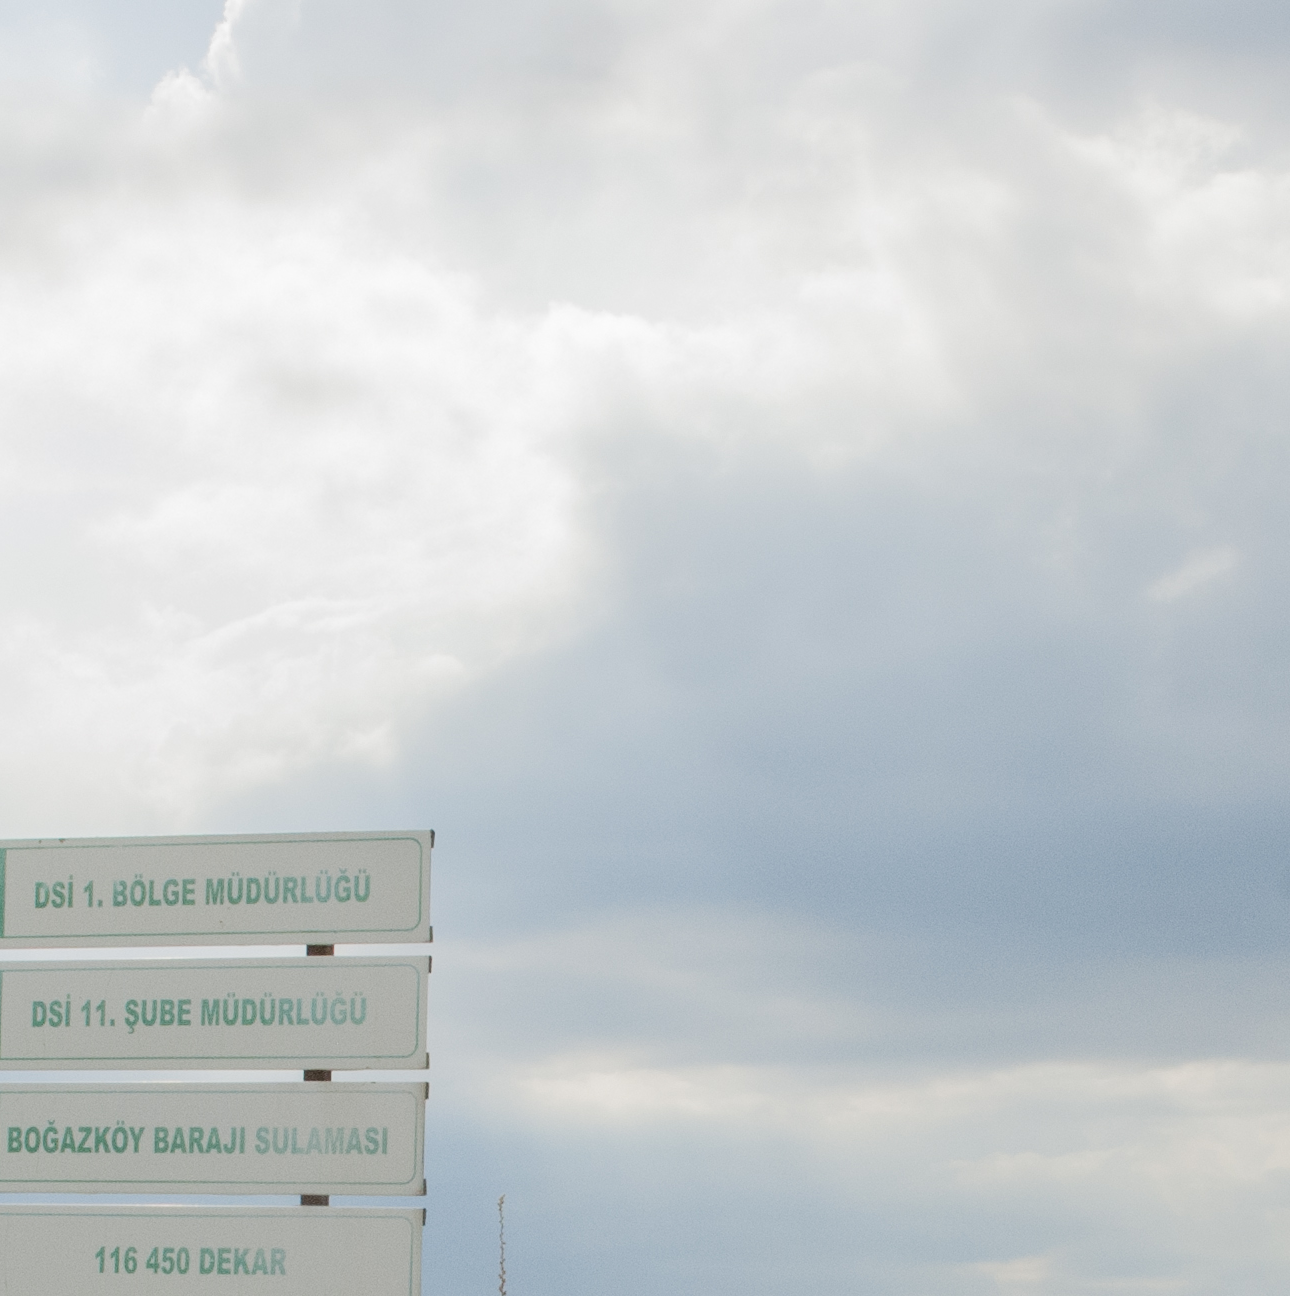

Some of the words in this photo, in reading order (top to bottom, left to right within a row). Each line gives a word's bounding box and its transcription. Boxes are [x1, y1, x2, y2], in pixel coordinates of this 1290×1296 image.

[34, 878, 74, 909] DSİ
[83, 880, 103, 908] 1.
[112, 873, 196, 907] BÖLGE
[205, 867, 371, 906] MÜDÜRLÜĞÜ
[32, 997, 72, 1028] DSİ
[81, 999, 115, 1027] 11.
[125, 998, 192, 1033] ŞUBE
[201, 990, 367, 1027] MÜDÜRLÜĞÜ
[8, 1119, 145, 1155] BOĞAZKÖY
[154, 1126, 246, 1155] BARAJI
[255, 1126, 388, 1155] SULAMASI
[95, 1247, 138, 1274] 116
[146, 1248, 190, 1275] 450
[199, 1248, 287, 1276] DEKAR
